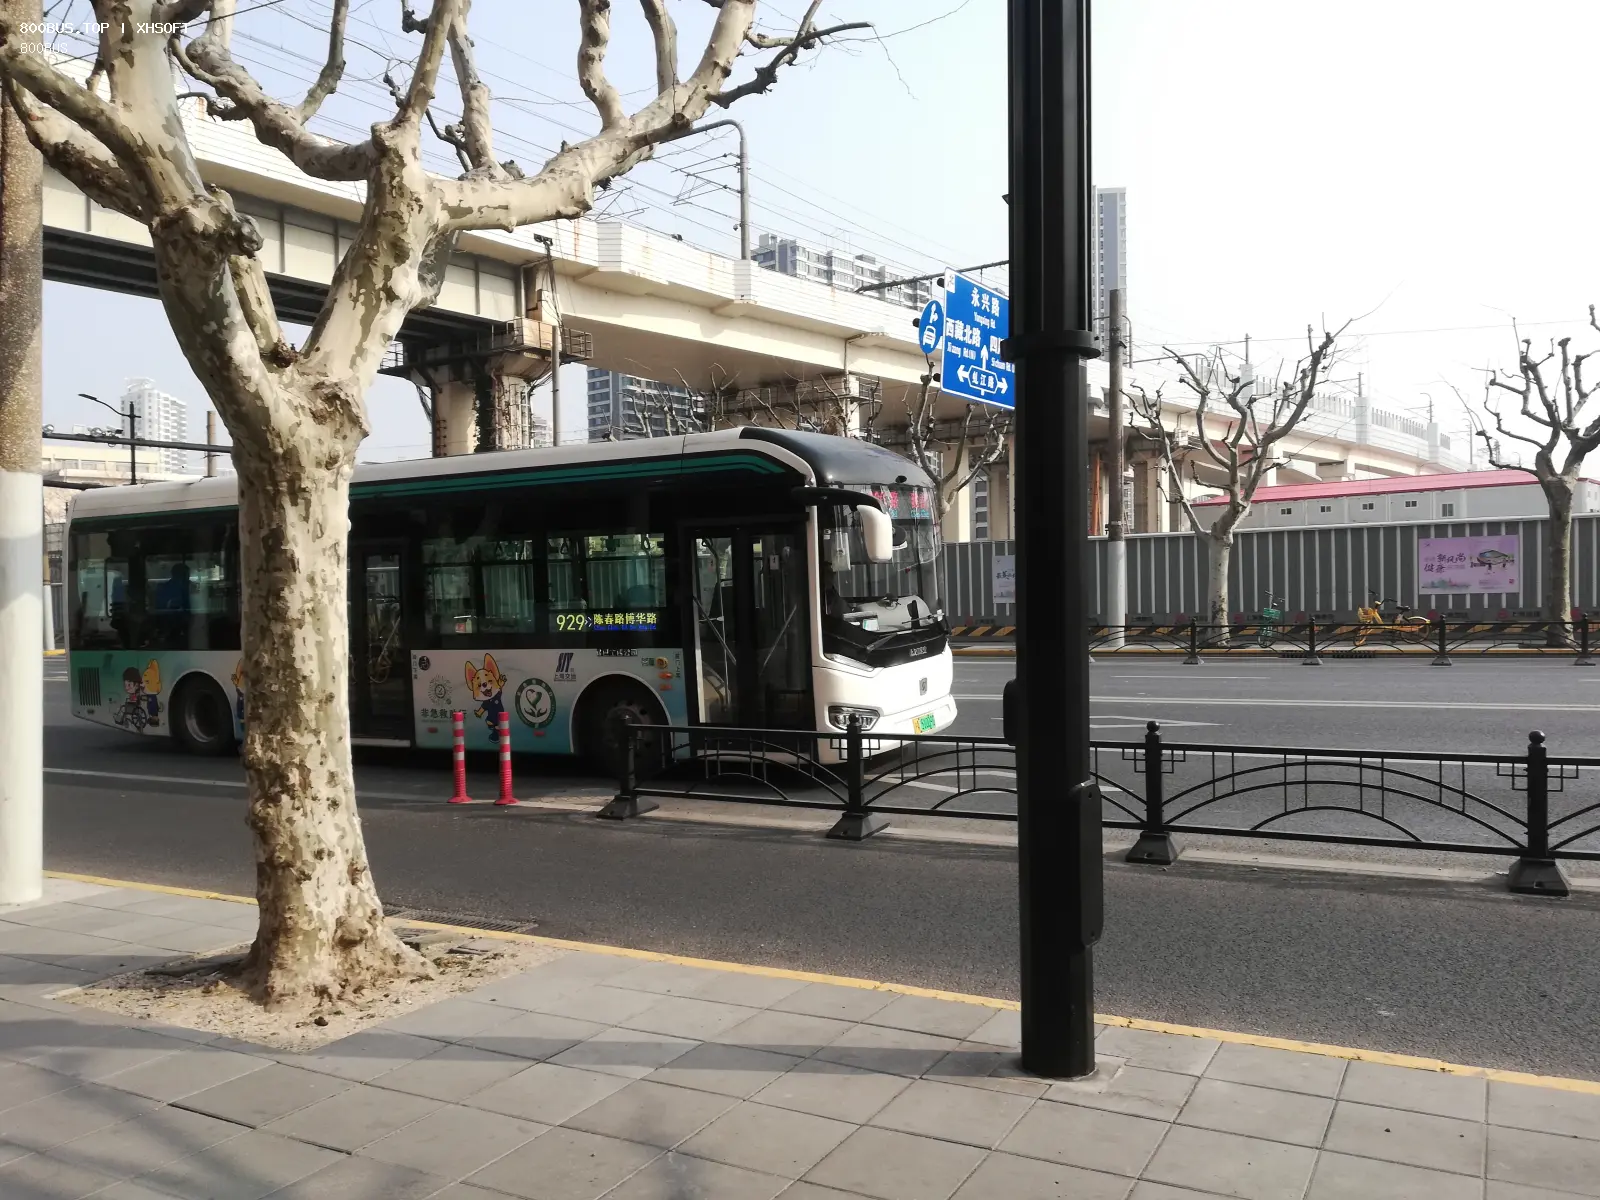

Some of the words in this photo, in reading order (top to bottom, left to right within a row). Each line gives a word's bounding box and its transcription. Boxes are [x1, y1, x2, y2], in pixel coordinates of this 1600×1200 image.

[972, 287, 999, 317] 永兴路
[946, 318, 980, 347] 西藏北路
[972, 371, 995, 389] 虬江路
[556, 614, 585, 631] 929
[593, 613, 657, 625] 陈春路博华路
